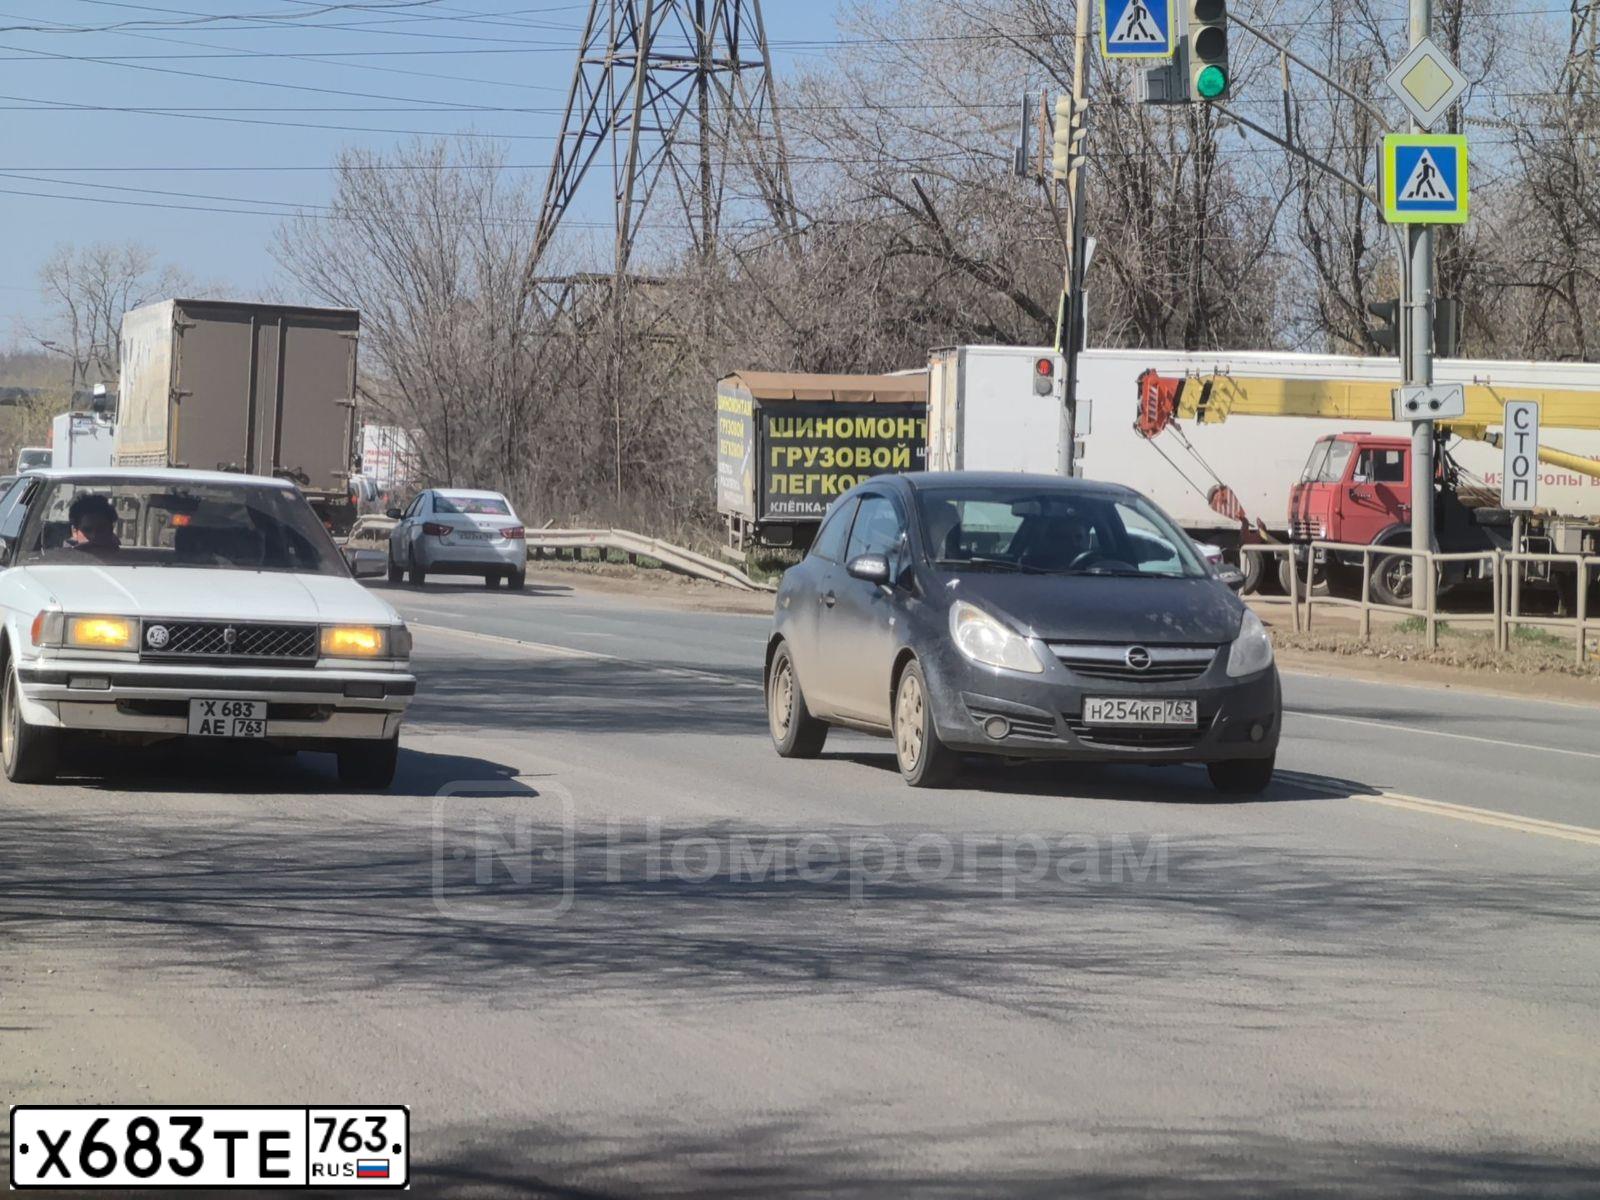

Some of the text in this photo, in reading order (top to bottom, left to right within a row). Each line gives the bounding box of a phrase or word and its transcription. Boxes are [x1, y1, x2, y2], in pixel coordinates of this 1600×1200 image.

[771, 443, 911, 468] ГРУЗОВОЙ
[1512, 408, 1530, 501] СТОП
[1091, 701, 1193, 720] Н254КР 763
[199, 719, 262, 735] АЕ 763
